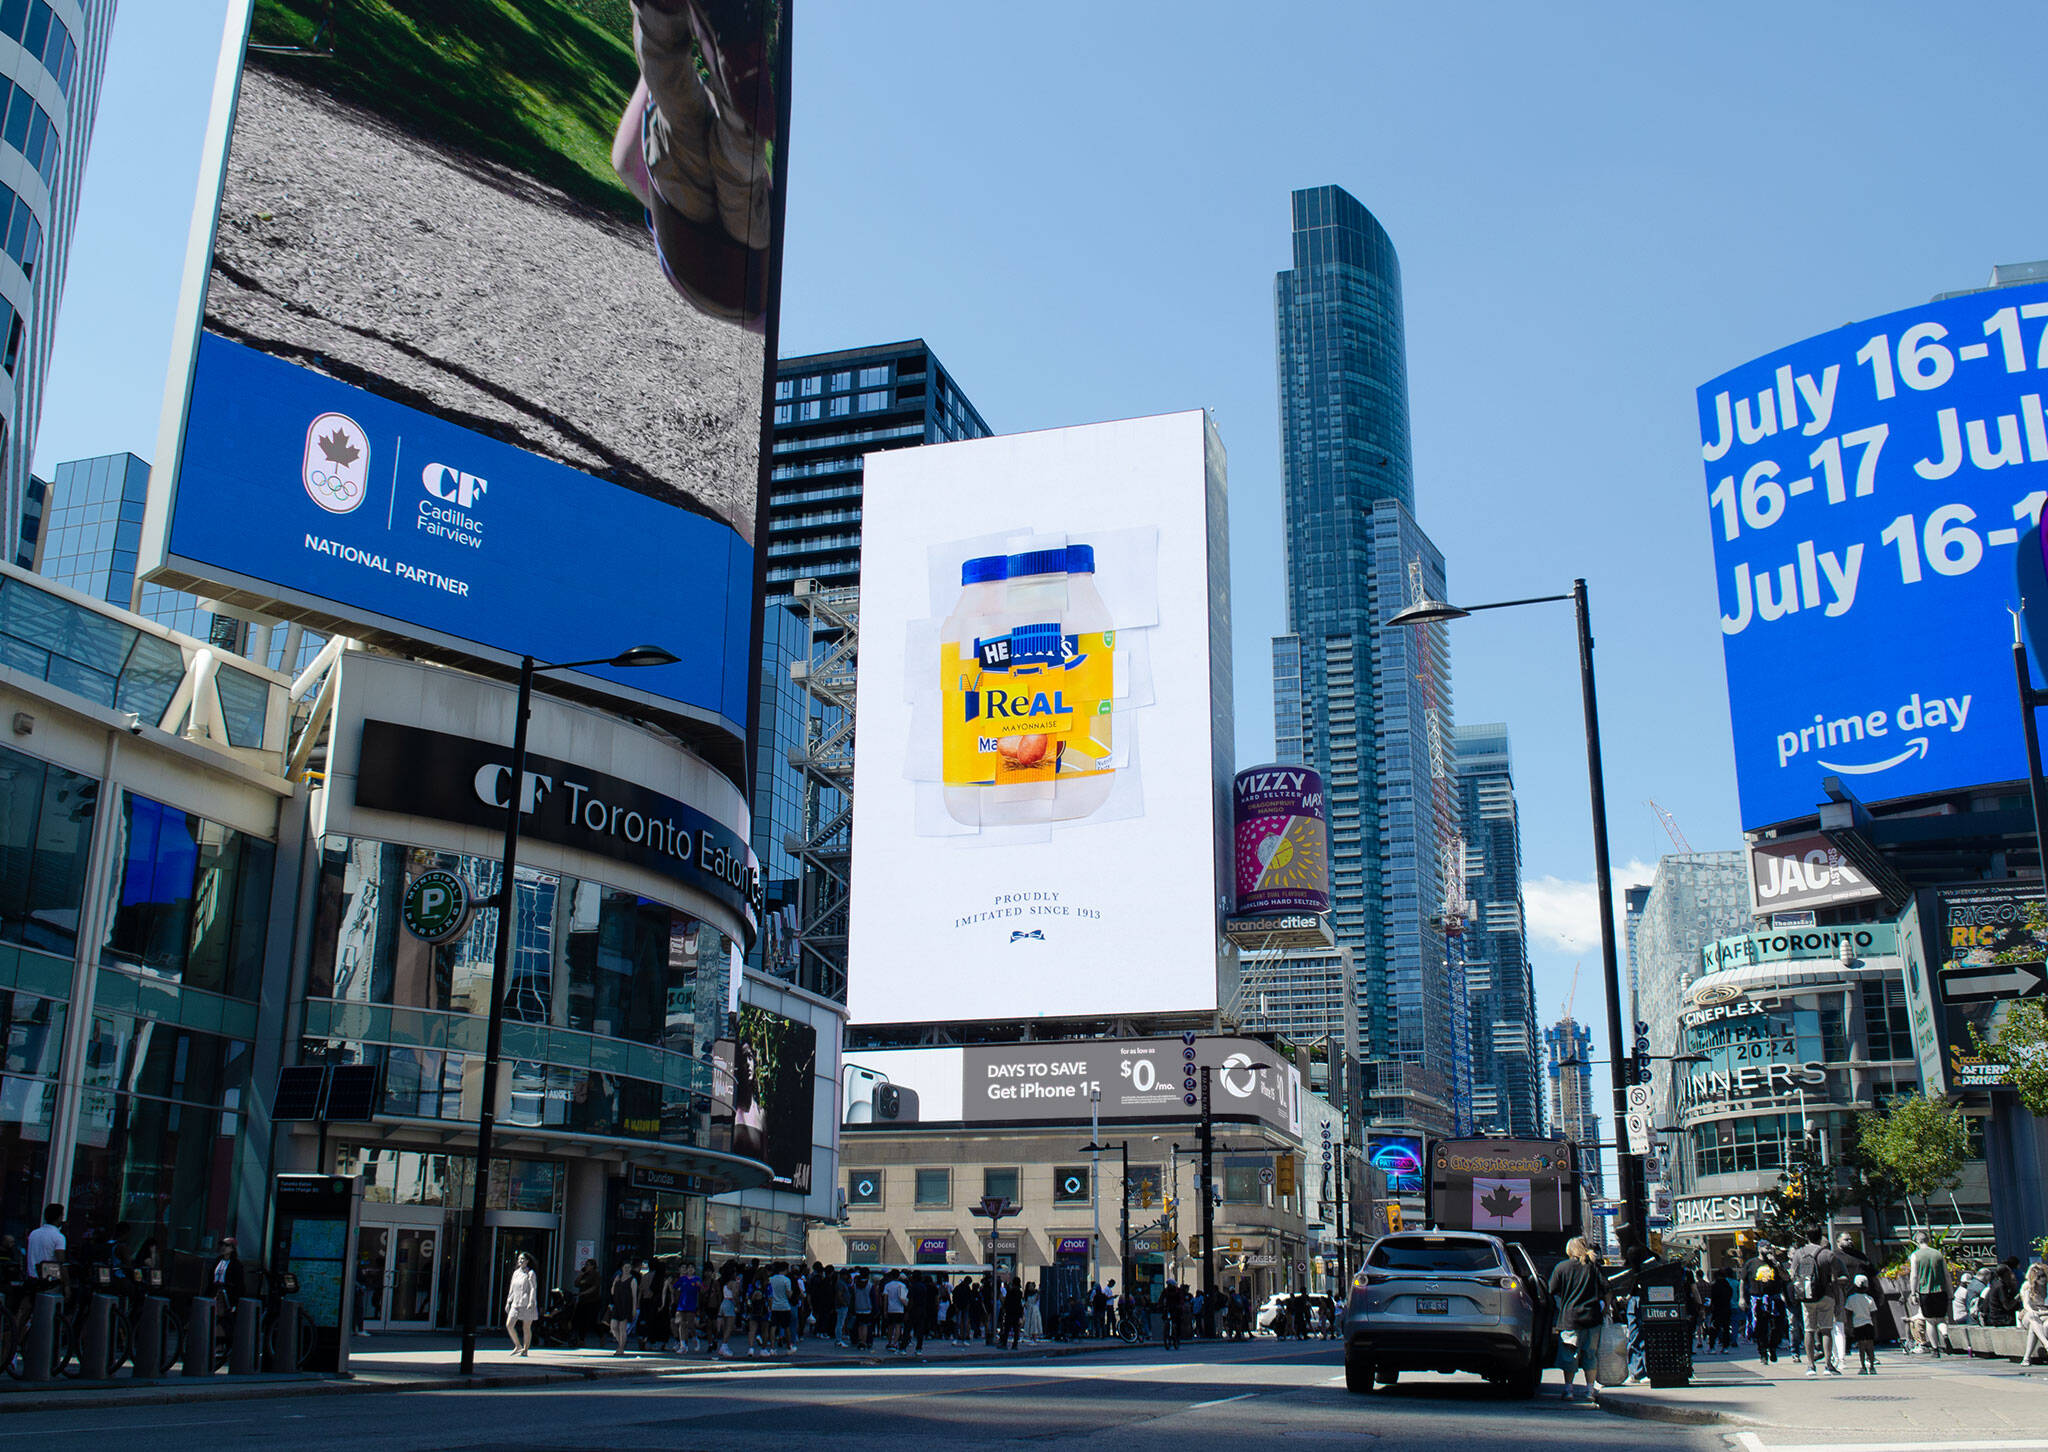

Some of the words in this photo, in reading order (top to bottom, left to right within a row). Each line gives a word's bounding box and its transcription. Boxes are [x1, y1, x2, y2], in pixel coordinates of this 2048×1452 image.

[1702, 364, 1841, 462] July
[1710, 423, 1889, 542] 16-17
[1913, 393, 2048, 481] Jul
[422, 462, 488, 508] CF
[419, 500, 483, 534] Cadillac
[417, 515, 482, 549] Fairview
[304, 533, 391, 574] NATIONAL
[395, 562, 470, 598] PARTNER
[1721, 540, 1864, 635] July
[1002, 721, 1057, 732] MAYONNAISE
[1776, 710, 1888, 768] prime
[1896, 693, 1972, 732] day
[1236, 771, 1306, 796] VIZZY
[1263, 791, 1302, 799] SELTZER
[1302, 793, 1322, 809] MAX
[473, 763, 552, 815] CF
[563, 780, 692, 861] Toronto
[700, 829, 750, 895] Eaton
[407, 873, 460, 900] MUNICIPAL
[995, 892, 1060, 904] PROUDLY
[422, 887, 446, 915] P
[405, 908, 460, 935] PARKING
[955, 907, 1022, 928] IMITATED
[1030, 906, 1070, 915] SINCE
[1077, 907, 1101, 919] 1913
[1227, 915, 1317, 931] brandedcities
[1757, 930, 1873, 954] TORONTO
[1685, 1001, 1765, 1025] CINEPLEX
[1735, 1023, 1794, 1042] FALL
[1120, 1047, 1129, 1055] for
[1737, 1040, 1796, 1060] 2024
[987, 1064, 1025, 1078] DAYS
[1027, 1064, 1048, 1076] TO
[1050, 1062, 1087, 1076] SAVE
[987, 1084, 1017, 1099] Get
[1020, 1083, 1076, 1098] iPhone
[1080, 1081, 1100, 1096] 15
[648, 1169, 675, 1185] Dundas
[1676, 1198, 1725, 1224] SHAKE
[1728, 1195, 1778, 1219] SHA
[852, 1240, 870, 1251] fido
[1134, 1240, 1150, 1250] ido
[1963, 1245, 1997, 1258] SHAC
[1646, 1308, 1667, 1318] Litter
